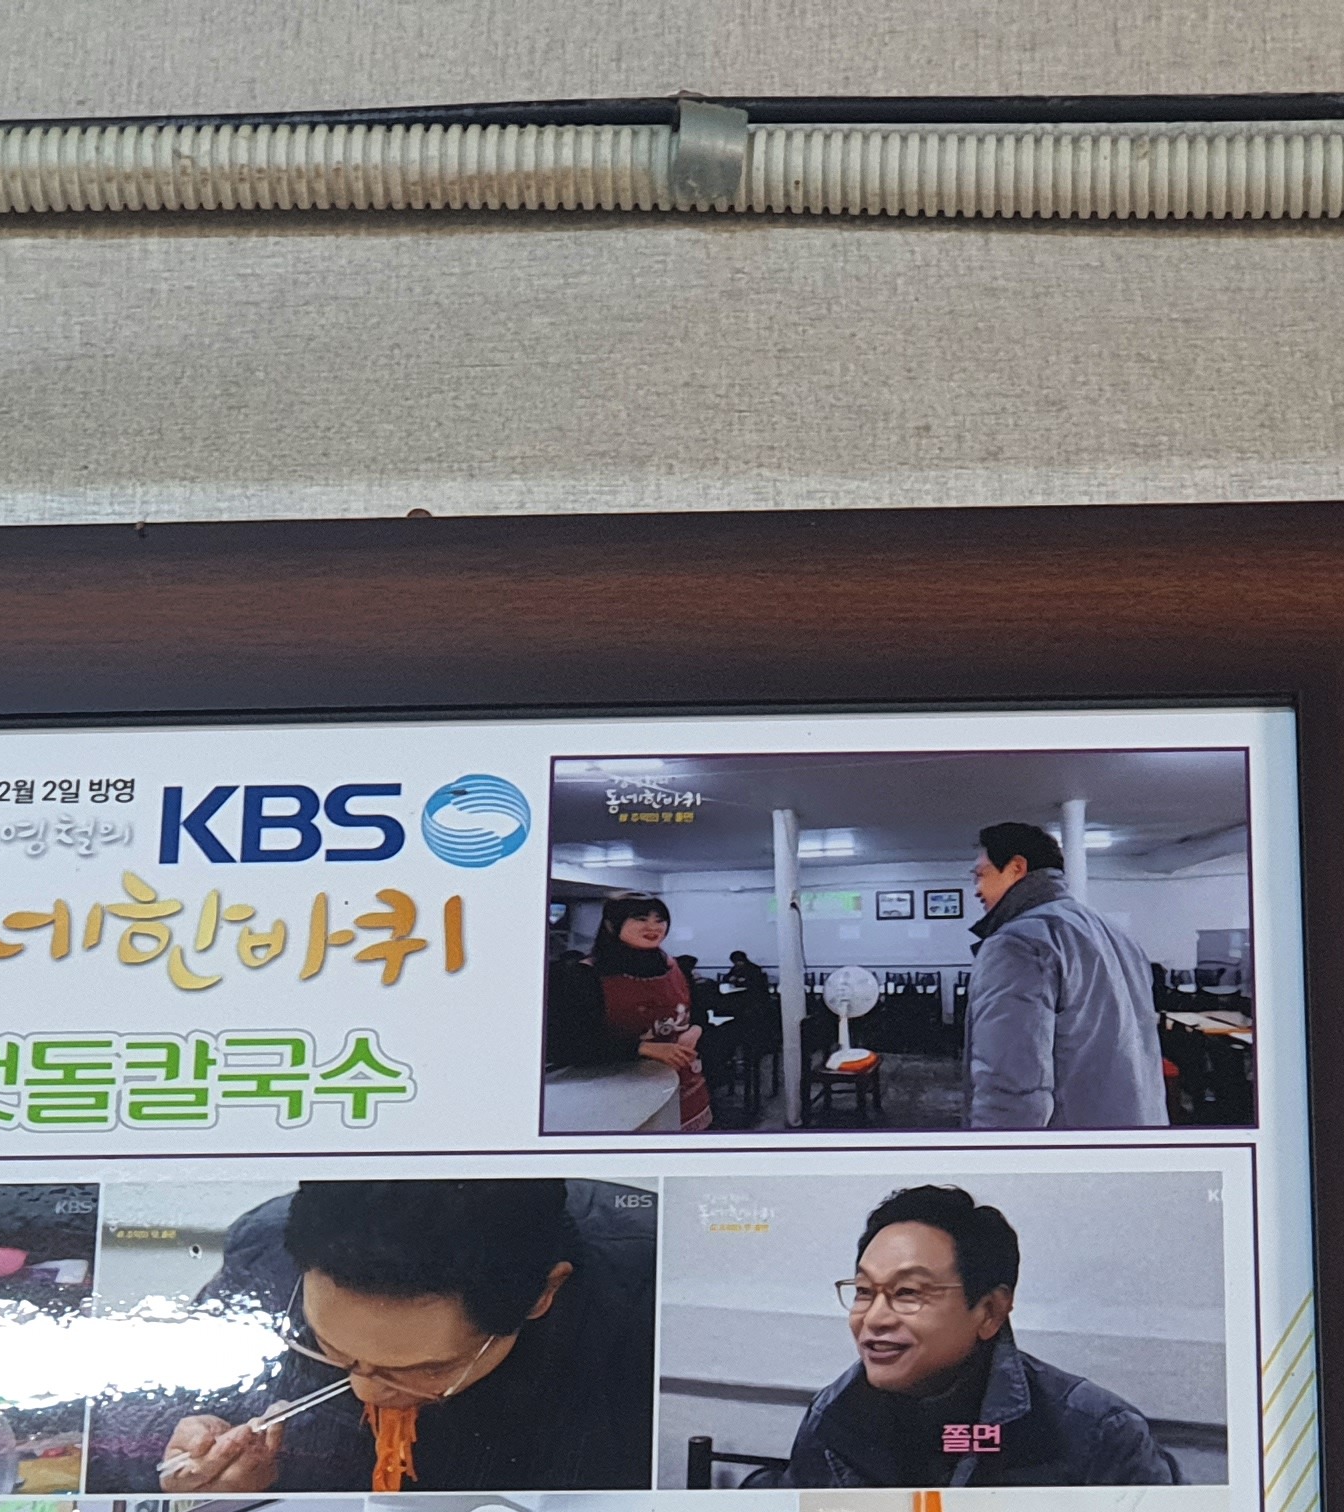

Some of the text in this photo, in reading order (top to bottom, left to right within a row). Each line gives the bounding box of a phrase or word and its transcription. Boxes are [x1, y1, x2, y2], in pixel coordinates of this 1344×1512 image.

[41, 778, 81, 804] 2일
[88, 777, 135, 804] 방영
[158, 782, 406, 865] KBS
[55, 1200, 93, 1214] KBS
[614, 1194, 654, 1208] KBS
[941, 1423, 1001, 1453] 쫄면
